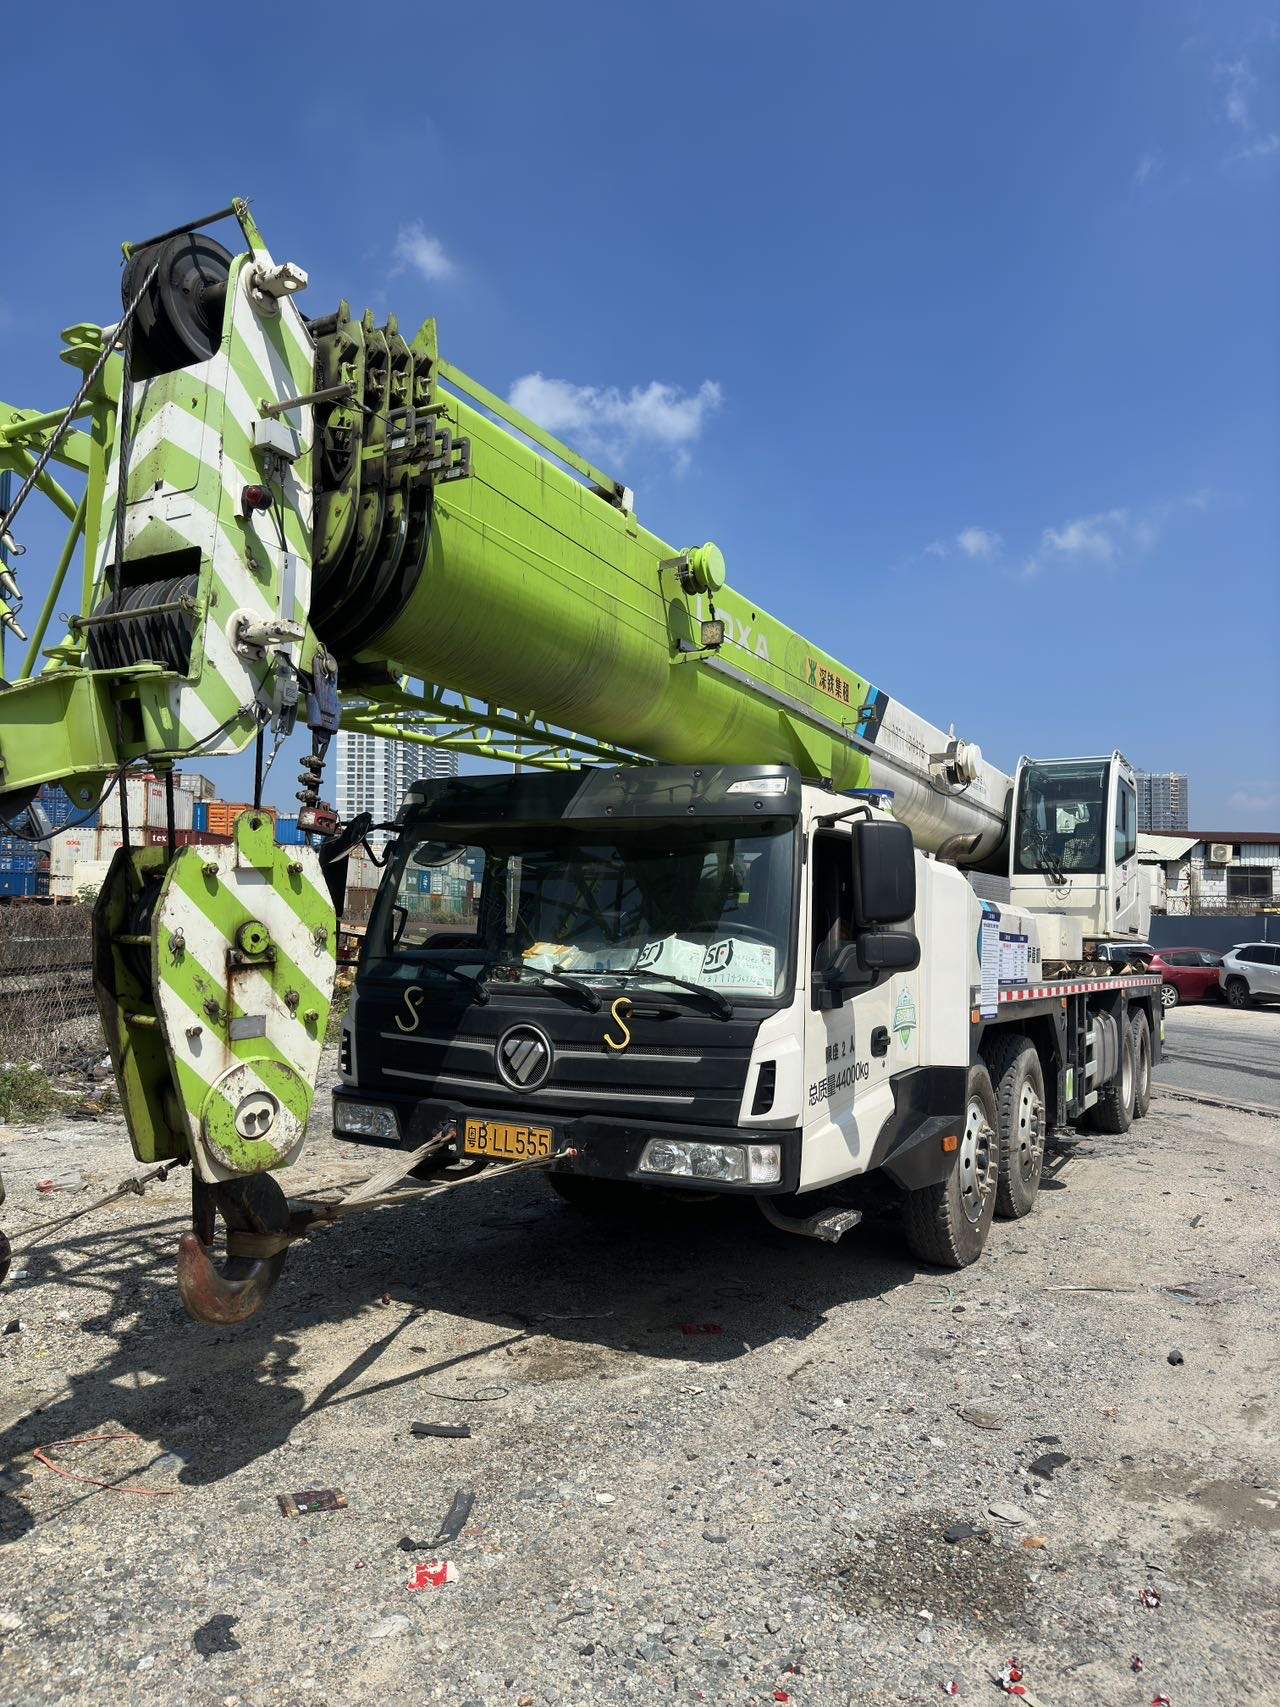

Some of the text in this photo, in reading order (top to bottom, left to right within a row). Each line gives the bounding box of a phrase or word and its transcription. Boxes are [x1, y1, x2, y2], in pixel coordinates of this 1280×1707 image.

[152, 834, 167, 842] tex
[808, 1061, 870, 1106] 总质量44000kg
